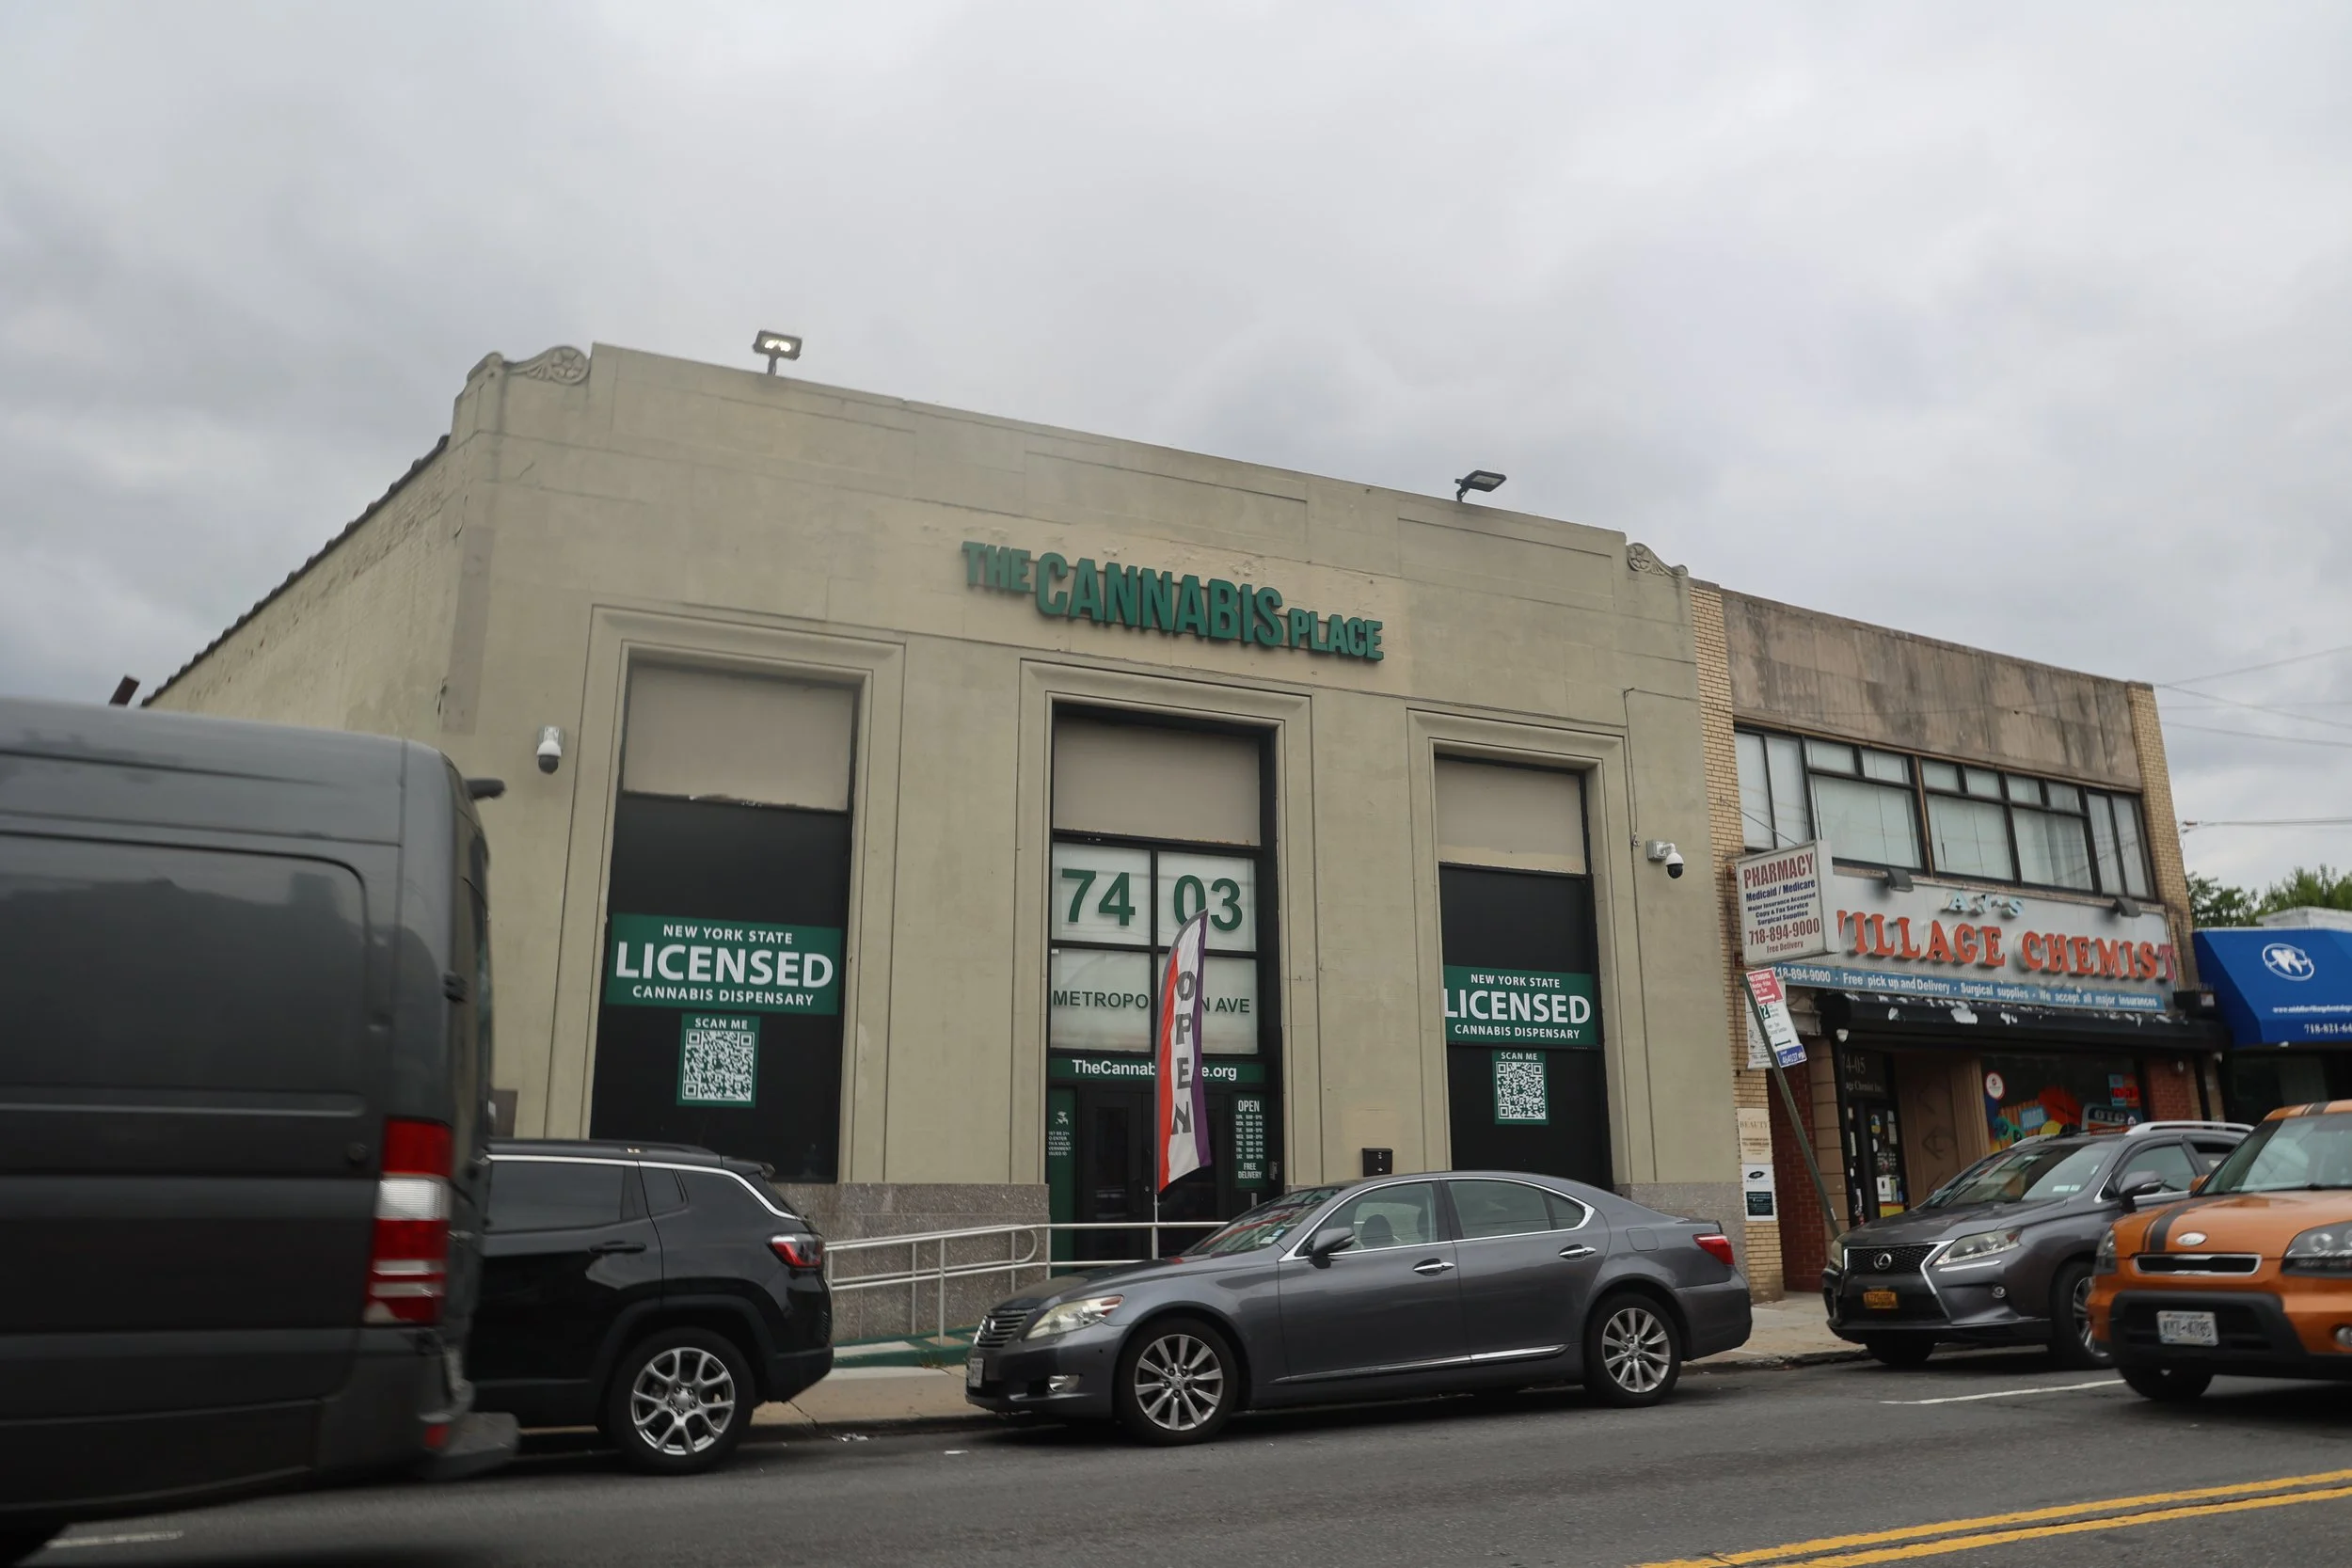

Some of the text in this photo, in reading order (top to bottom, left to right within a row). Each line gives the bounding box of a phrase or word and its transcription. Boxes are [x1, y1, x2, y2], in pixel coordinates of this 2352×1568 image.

[961, 541, 1384, 660] THE CANNABIS PLACE
[1743, 853, 1813, 889] PHARMACY
[1061, 868, 1243, 931] 74 03
[1746, 887, 1777, 902] Medicaid
[1783, 879, 1816, 895] Medicare
[1747, 892, 1816, 912] Major Insurance Accepted
[1756, 910, 1770, 918] Copy
[1776, 906, 1786, 914] Fax
[1787, 902, 1809, 911] Service
[1757, 911, 1808, 926] Surgical Supplies
[663, 924, 793, 944] NEW YORK STATE
[1749, 917, 1820, 945] 718-894-9000
[1766, 941, 1804, 954] Free Delivery
[2021, 930, 2176, 980] CHEMIST
[615, 941, 834, 989] LICENSED
[1470, 974, 1560, 989] NEW YORK STATE
[1772, 966, 2157, 1007] 718-894-9000 Free pick up and Delivery Surgical supplies We accept all major insurances
[632, 985, 814, 1006] CANNABIS DISPENSARY
[1215, 997, 1250, 1013] AVE
[1443, 989, 1591, 1024] LICENSED
[1761, 1006, 1769, 1019] 2
[694, 1018, 748, 1030] SCAN ME
[1454, 1024, 1580, 1039] CANNABIS DISPENSARY
[1170, 970, 1197, 1135] OPEN
[1501, 1052, 1537, 1061] SCAN ME
[1238, 1100, 1260, 1112] OPEN
[1740, 1120, 1769, 1129] BEAUTY
[1237, 1171, 1263, 1180] DELIVERY
[1243, 1163, 1257, 1171] FREE
